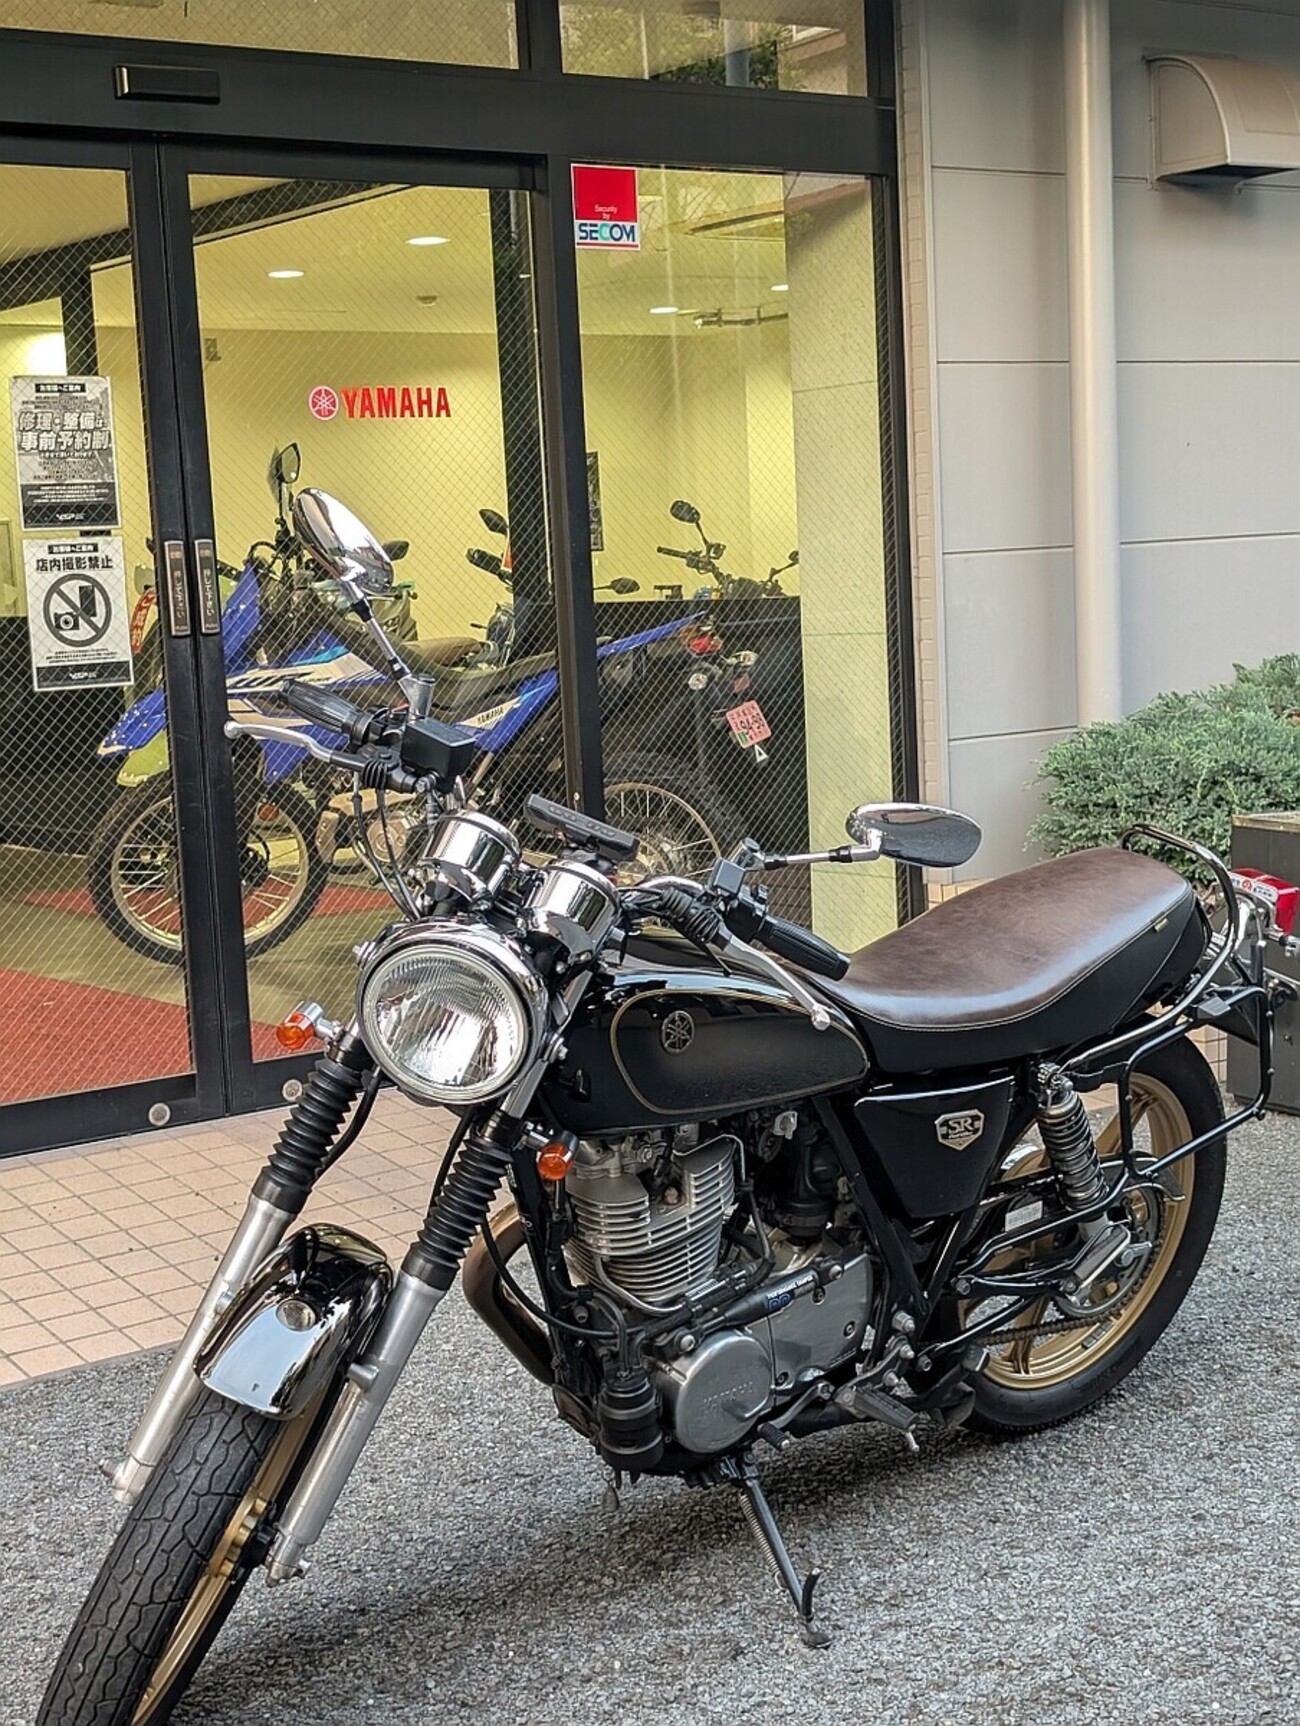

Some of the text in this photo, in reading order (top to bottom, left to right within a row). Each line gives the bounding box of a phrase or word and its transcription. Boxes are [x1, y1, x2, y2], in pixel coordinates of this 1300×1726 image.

[594, 204, 618, 213] Security
[578, 222, 636, 242] SECOM
[341, 386, 452, 418] YAMAHA
[20, 431, 110, 451] 事前予約制
[35, 555, 114, 572] 店内撮影禁止
[948, 1117, 975, 1133] SR
